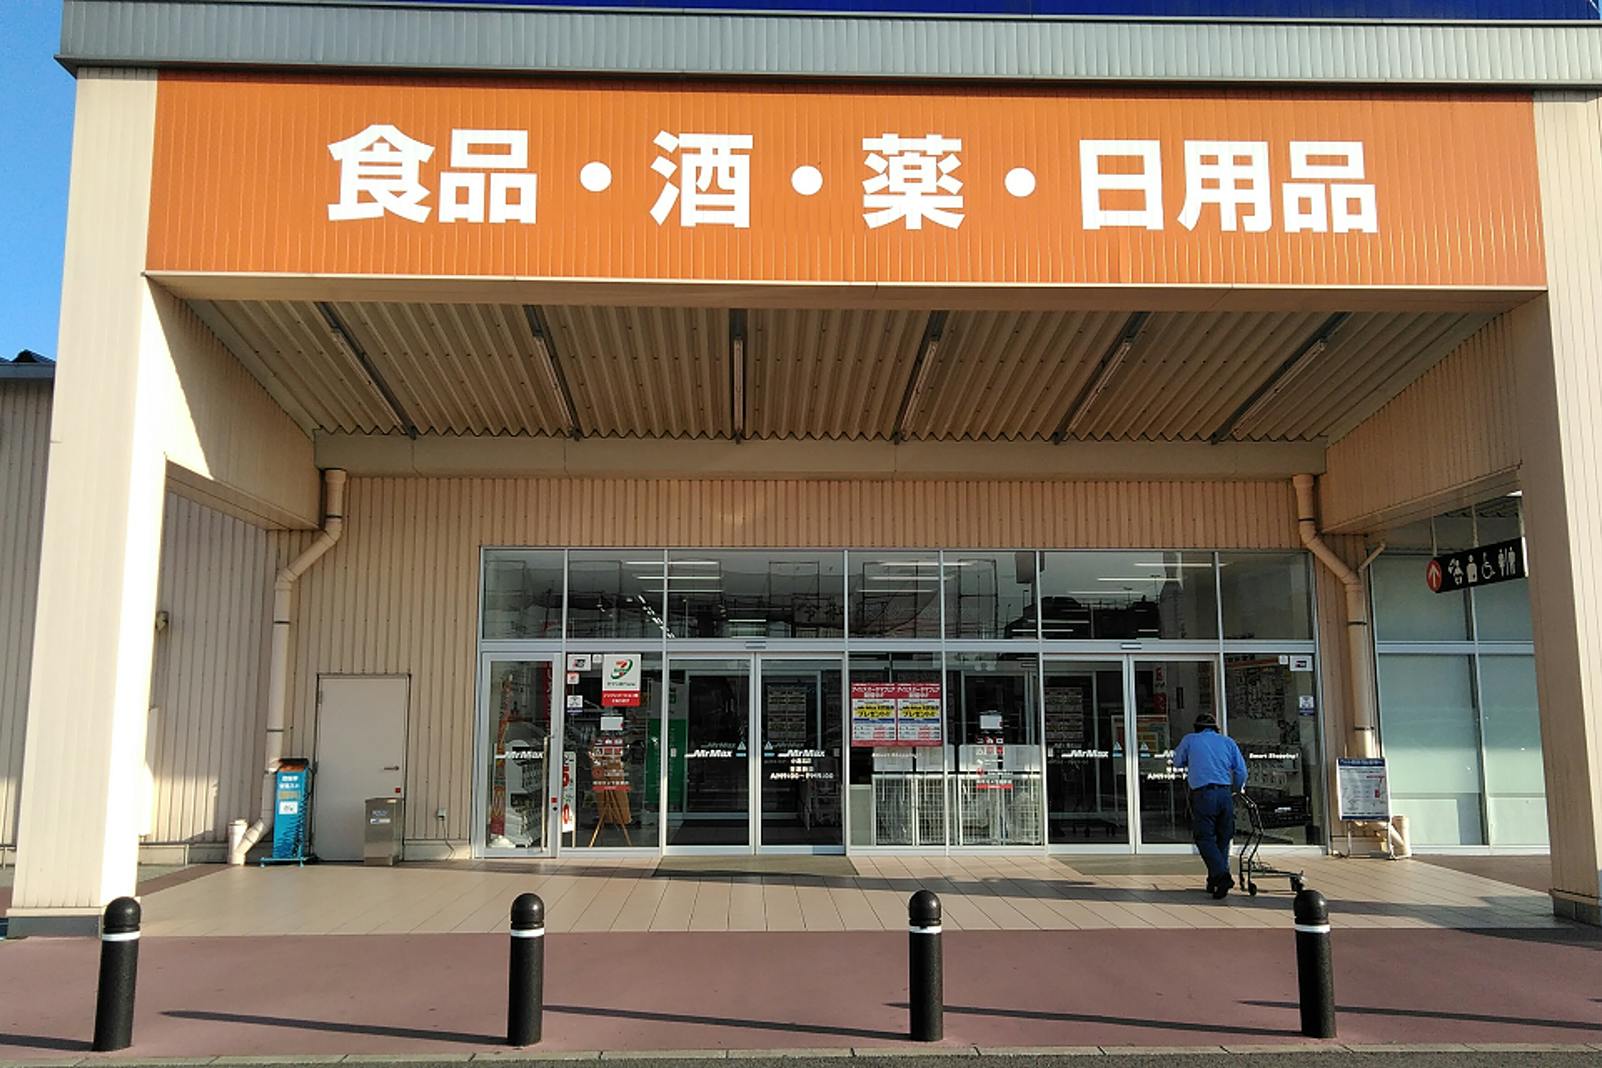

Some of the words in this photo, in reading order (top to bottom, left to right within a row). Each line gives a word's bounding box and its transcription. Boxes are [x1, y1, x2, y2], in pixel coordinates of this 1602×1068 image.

[328, 125, 1377, 232] 食品・酒・薬・日用品
[684, 749, 733, 758] MrMax
[777, 749, 825, 758] MrMax
[1061, 749, 1109, 758] MrMax
